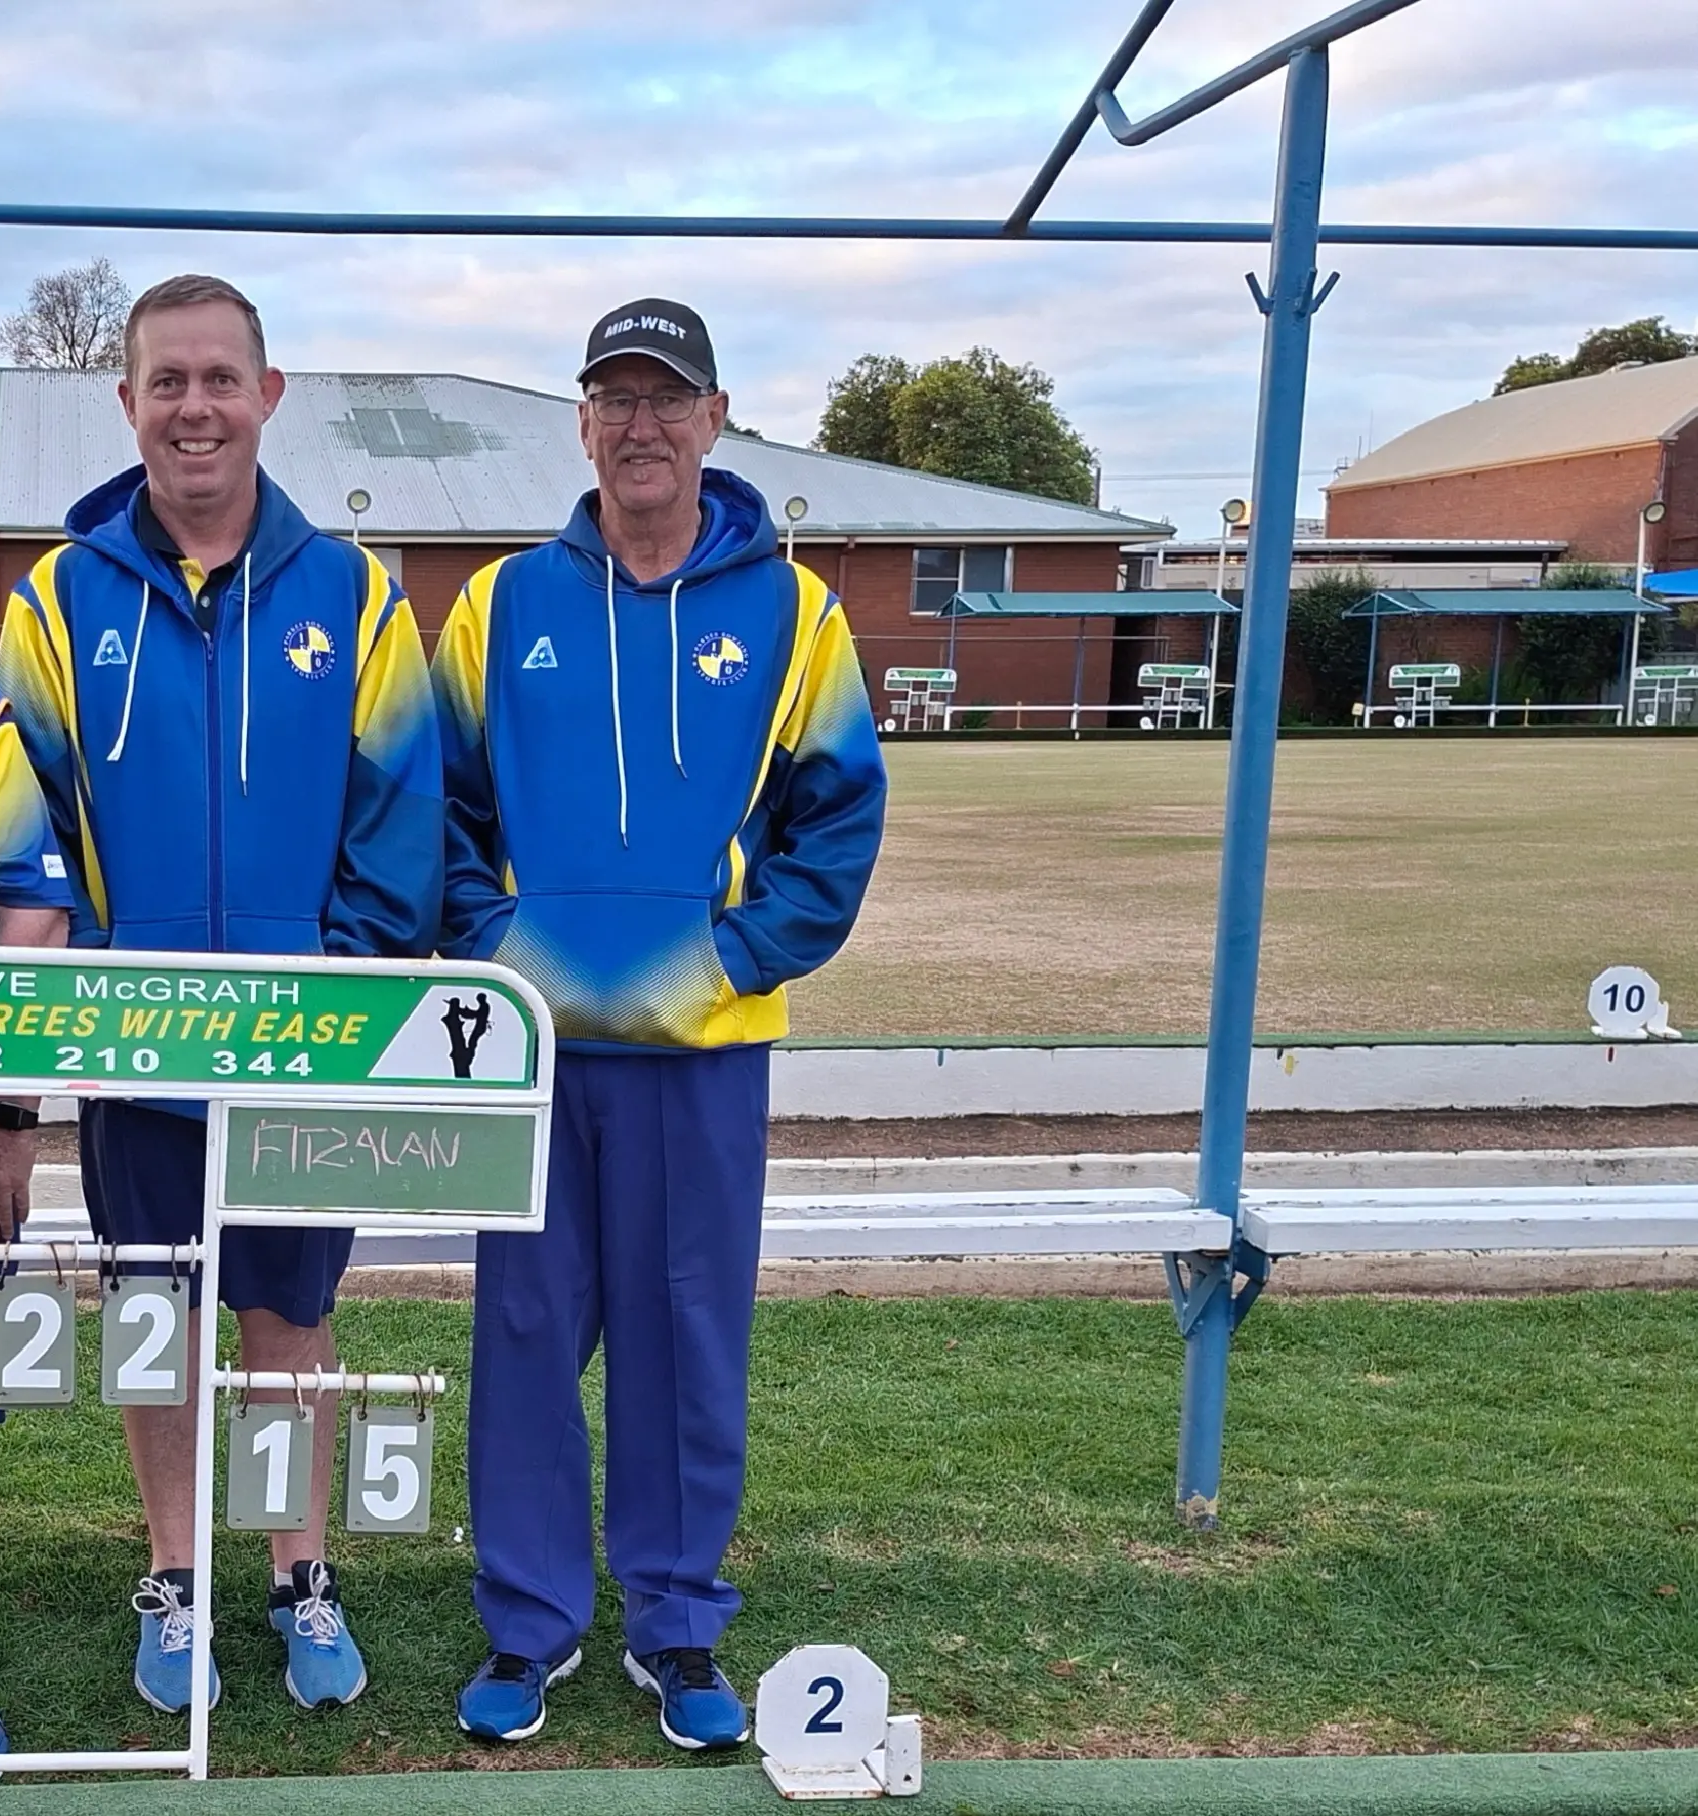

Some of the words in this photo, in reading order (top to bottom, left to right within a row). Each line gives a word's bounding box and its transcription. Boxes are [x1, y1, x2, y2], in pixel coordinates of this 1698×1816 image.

[604, 315, 686, 340] MID-WEST
[75, 975, 299, 1005] McGRATH
[1603, 984, 1645, 1013] 10
[120, 1007, 237, 1042] WITH
[251, 1011, 369, 1045] EASE
[55, 1046, 160, 1073] 210
[211, 1050, 313, 1077] 344
[804, 1675, 845, 1734] 2
